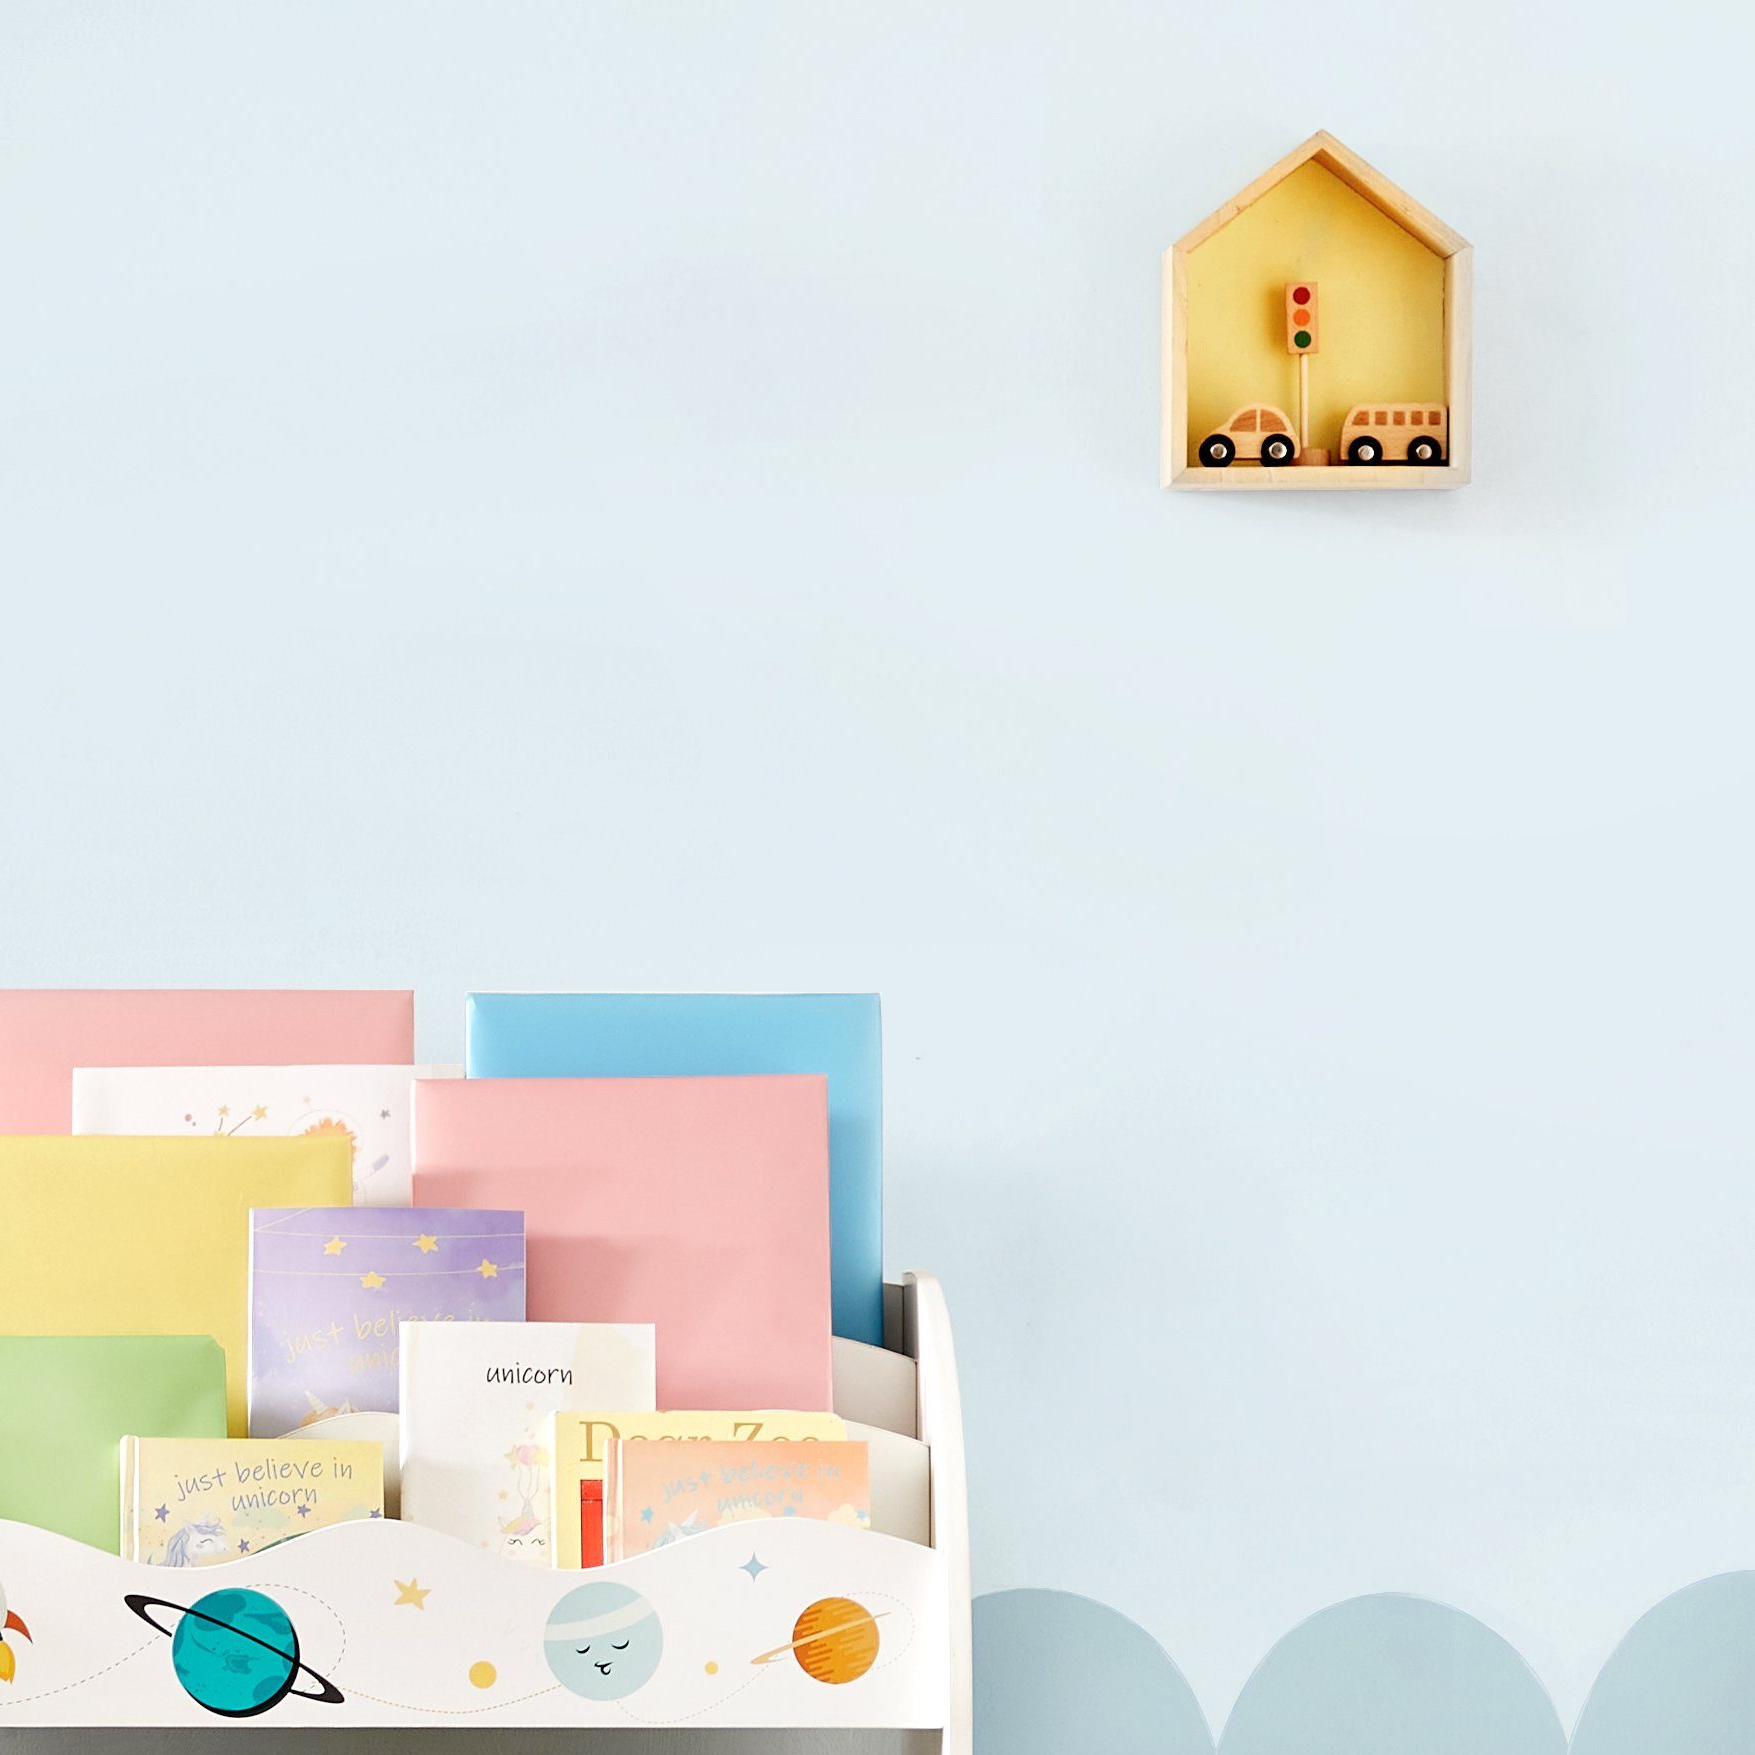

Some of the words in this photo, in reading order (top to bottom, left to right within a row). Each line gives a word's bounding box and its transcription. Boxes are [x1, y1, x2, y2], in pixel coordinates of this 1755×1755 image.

[283, 1320, 344, 1364] just
[486, 1361, 573, 1386] unicorn
[174, 1468, 227, 1502] just
[235, 1457, 324, 1483] believe
[333, 1456, 353, 1480] in
[231, 1486, 318, 1512] unicorn
